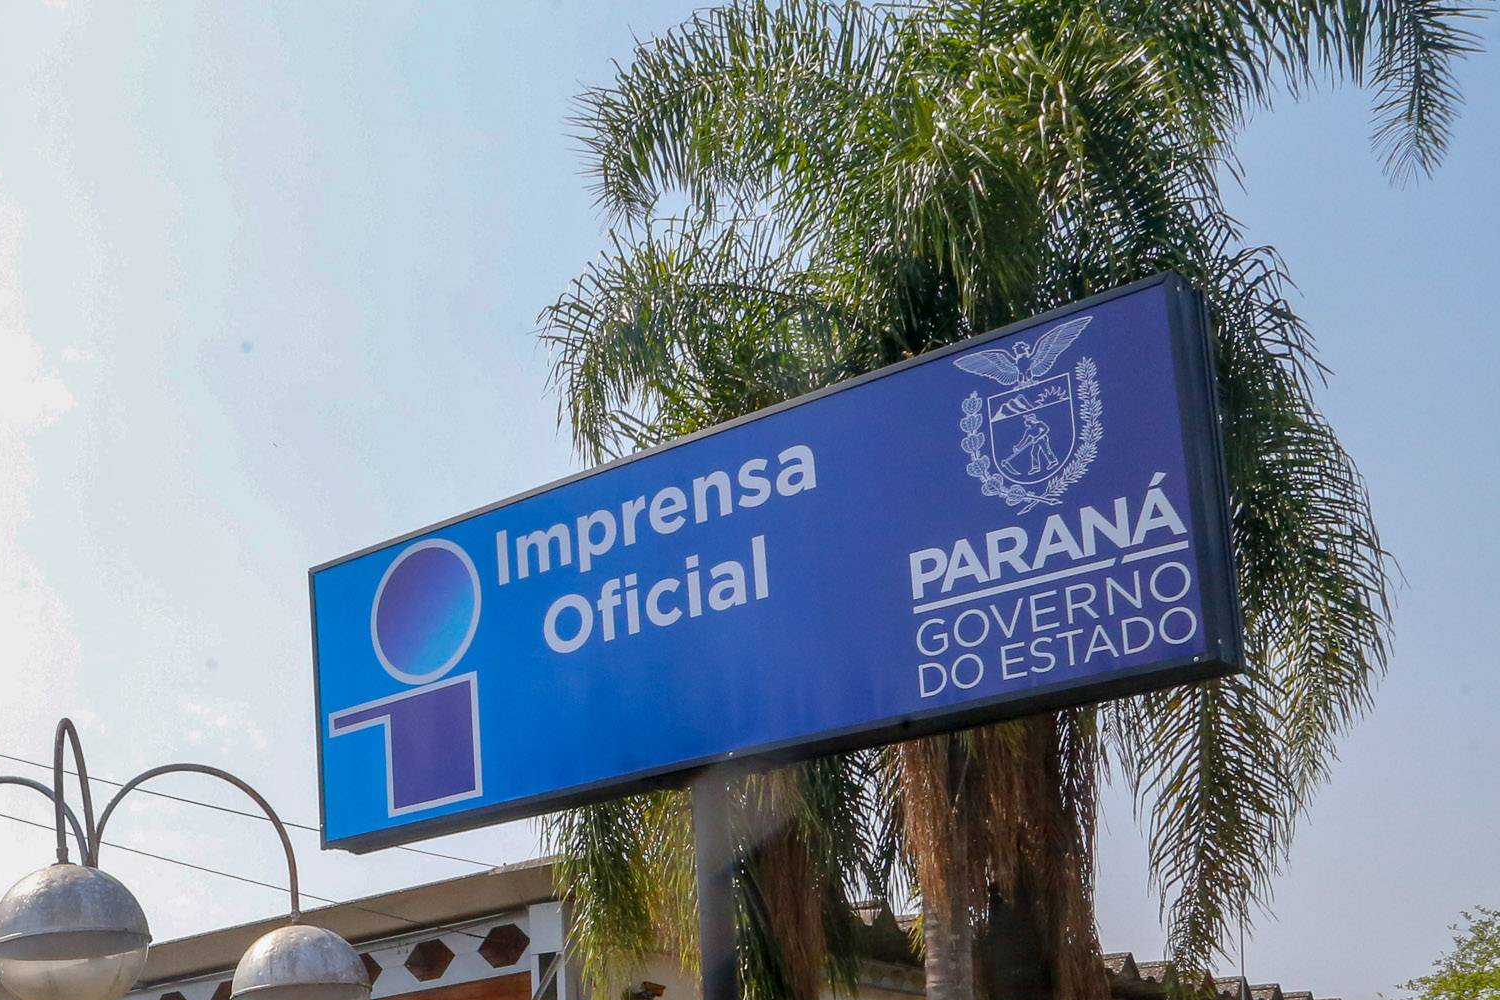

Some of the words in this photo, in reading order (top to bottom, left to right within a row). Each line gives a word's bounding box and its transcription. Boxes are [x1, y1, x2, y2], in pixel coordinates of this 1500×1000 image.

[495, 442, 819, 588] Imprensa
[909, 470, 1190, 601] PARANÁ
[543, 534, 771, 655] Oficial
[915, 560, 1192, 657] GOVERNO
[917, 652, 985, 699] DO
[1000, 605, 1198, 681] ESTADO
